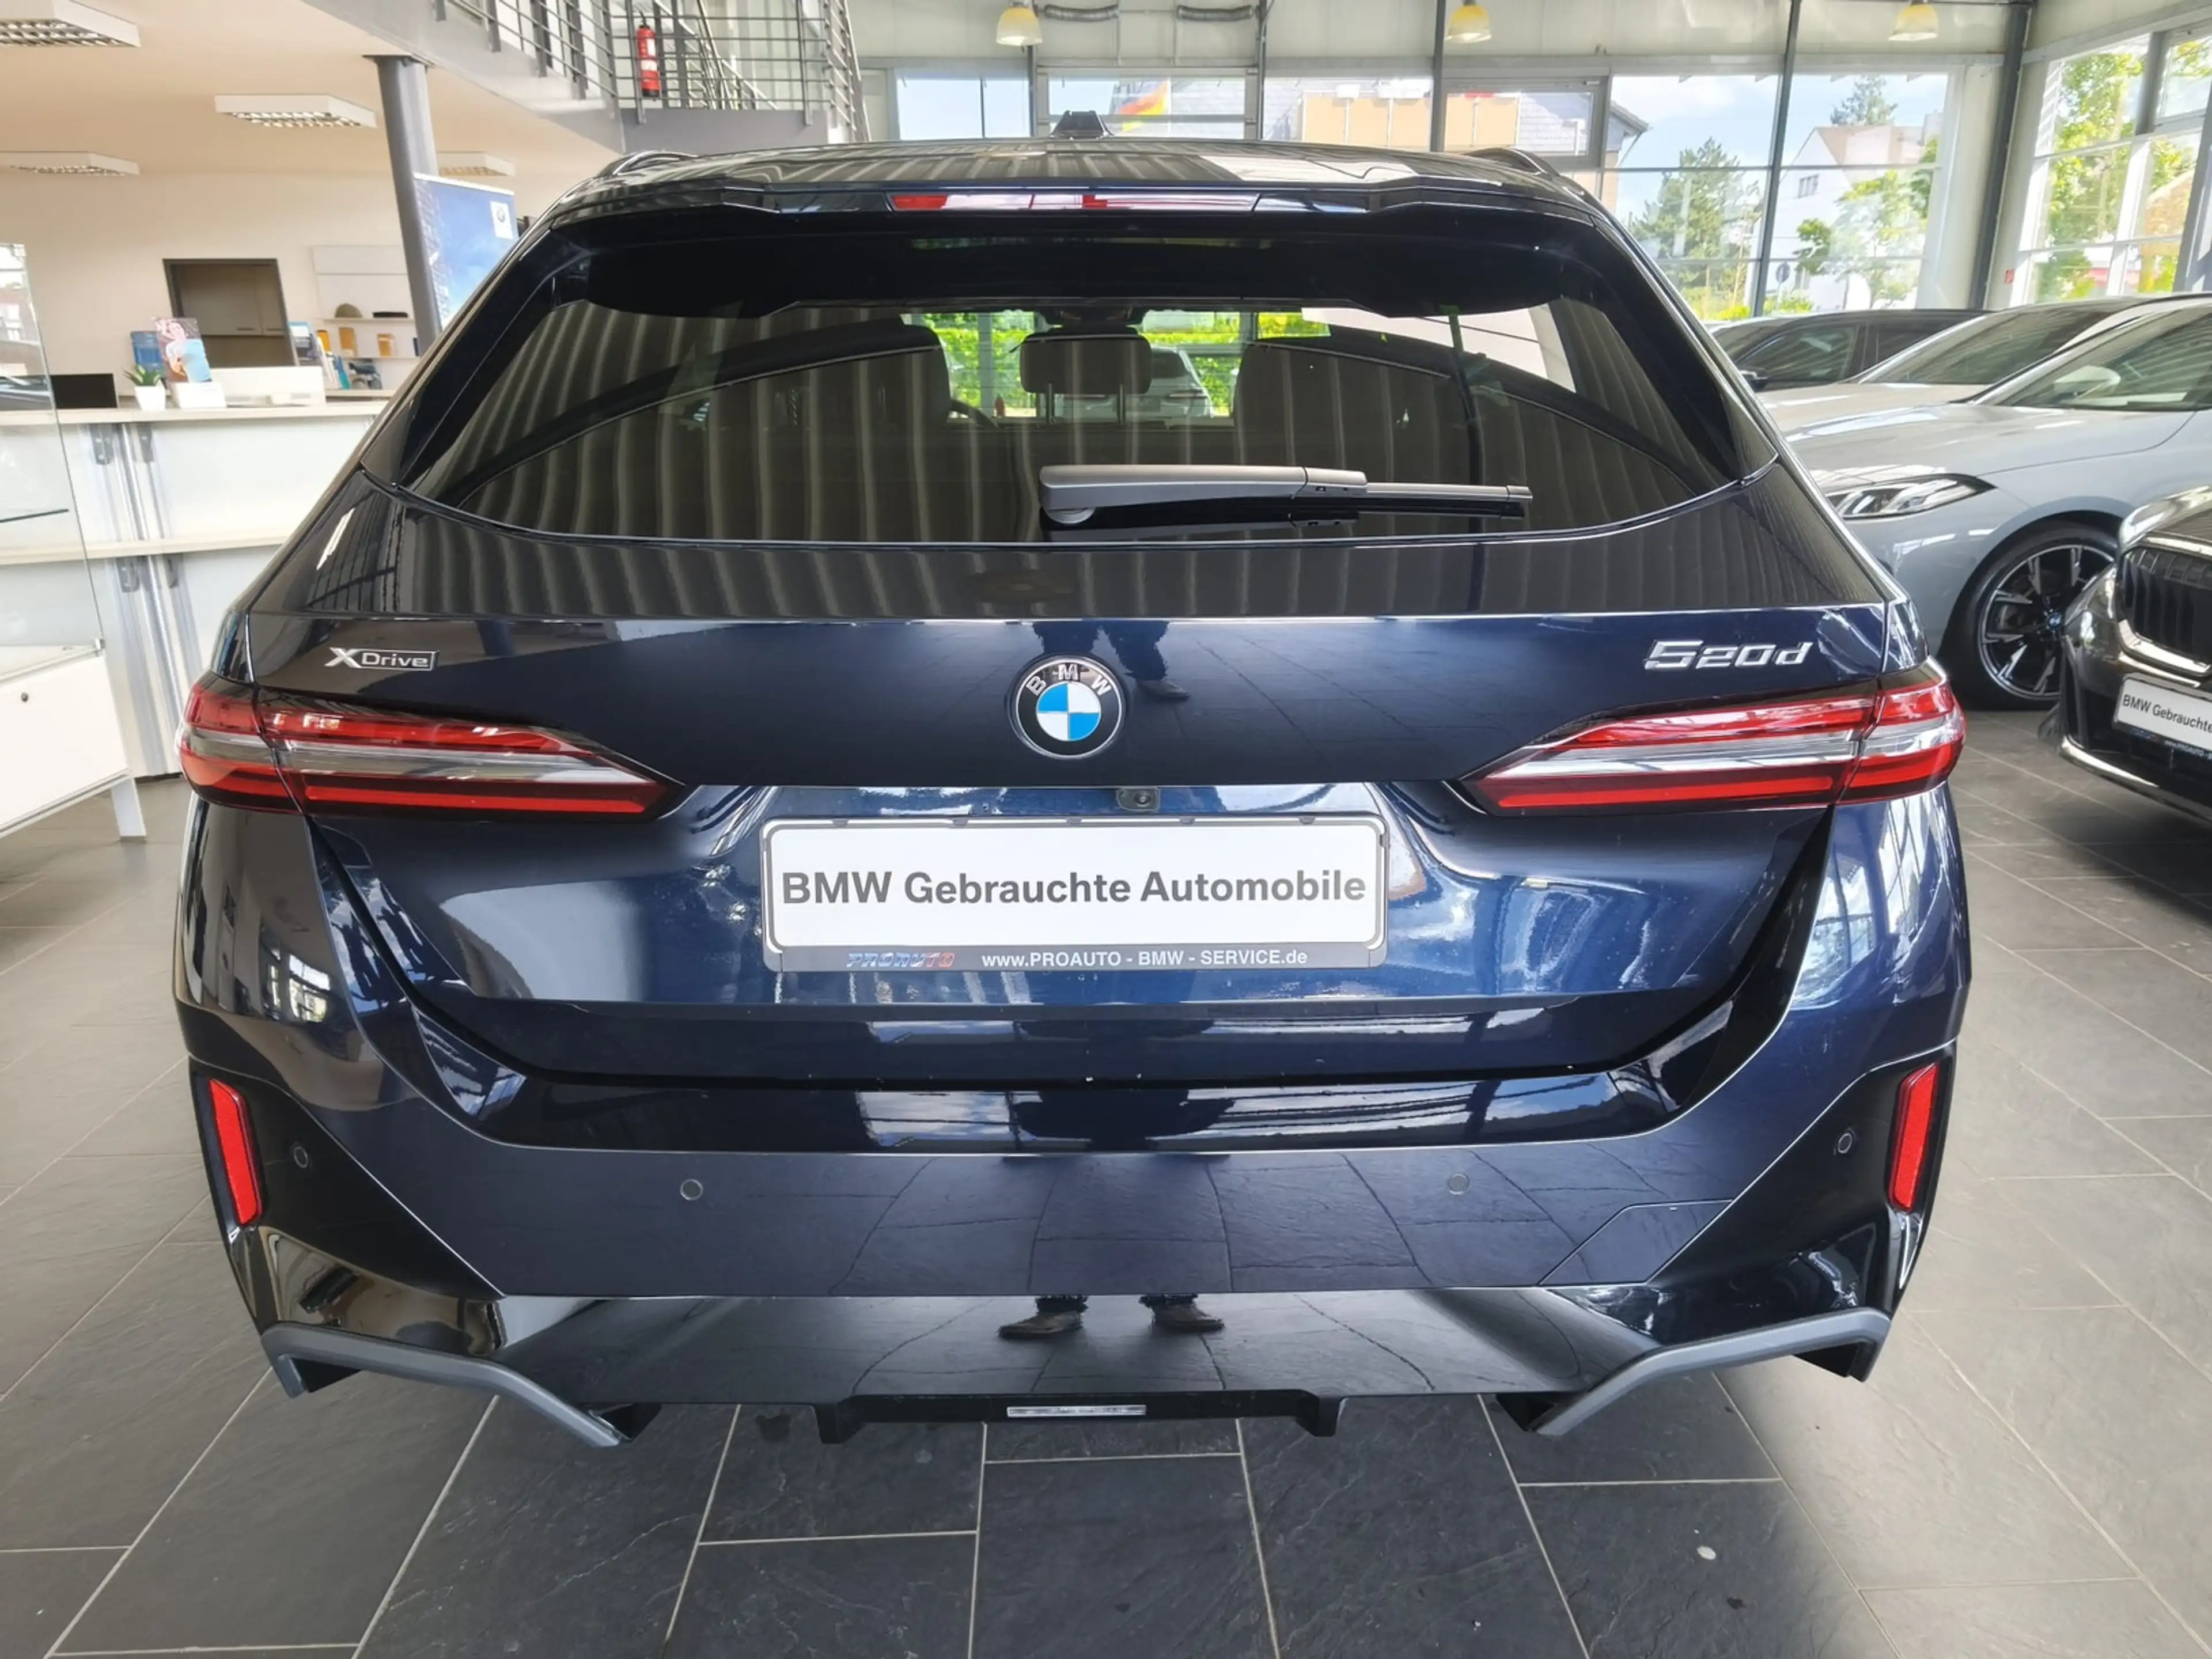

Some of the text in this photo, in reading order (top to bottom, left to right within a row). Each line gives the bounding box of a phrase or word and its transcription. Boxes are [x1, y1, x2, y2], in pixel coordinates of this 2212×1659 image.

[1643, 639, 1814, 671] 520d
[1025, 663, 1112, 696] BMW
[2122, 693, 2212, 734] BMW Gebrauchte
[782, 869, 1366, 904] BMW Gebrauchte Automobile
[846, 952, 956, 968] PROAUTO
[981, 951, 1122, 967] www.PROAUTO
[1138, 950, 1184, 966] BMW
[1200, 949, 1308, 965] SERVICE.de
